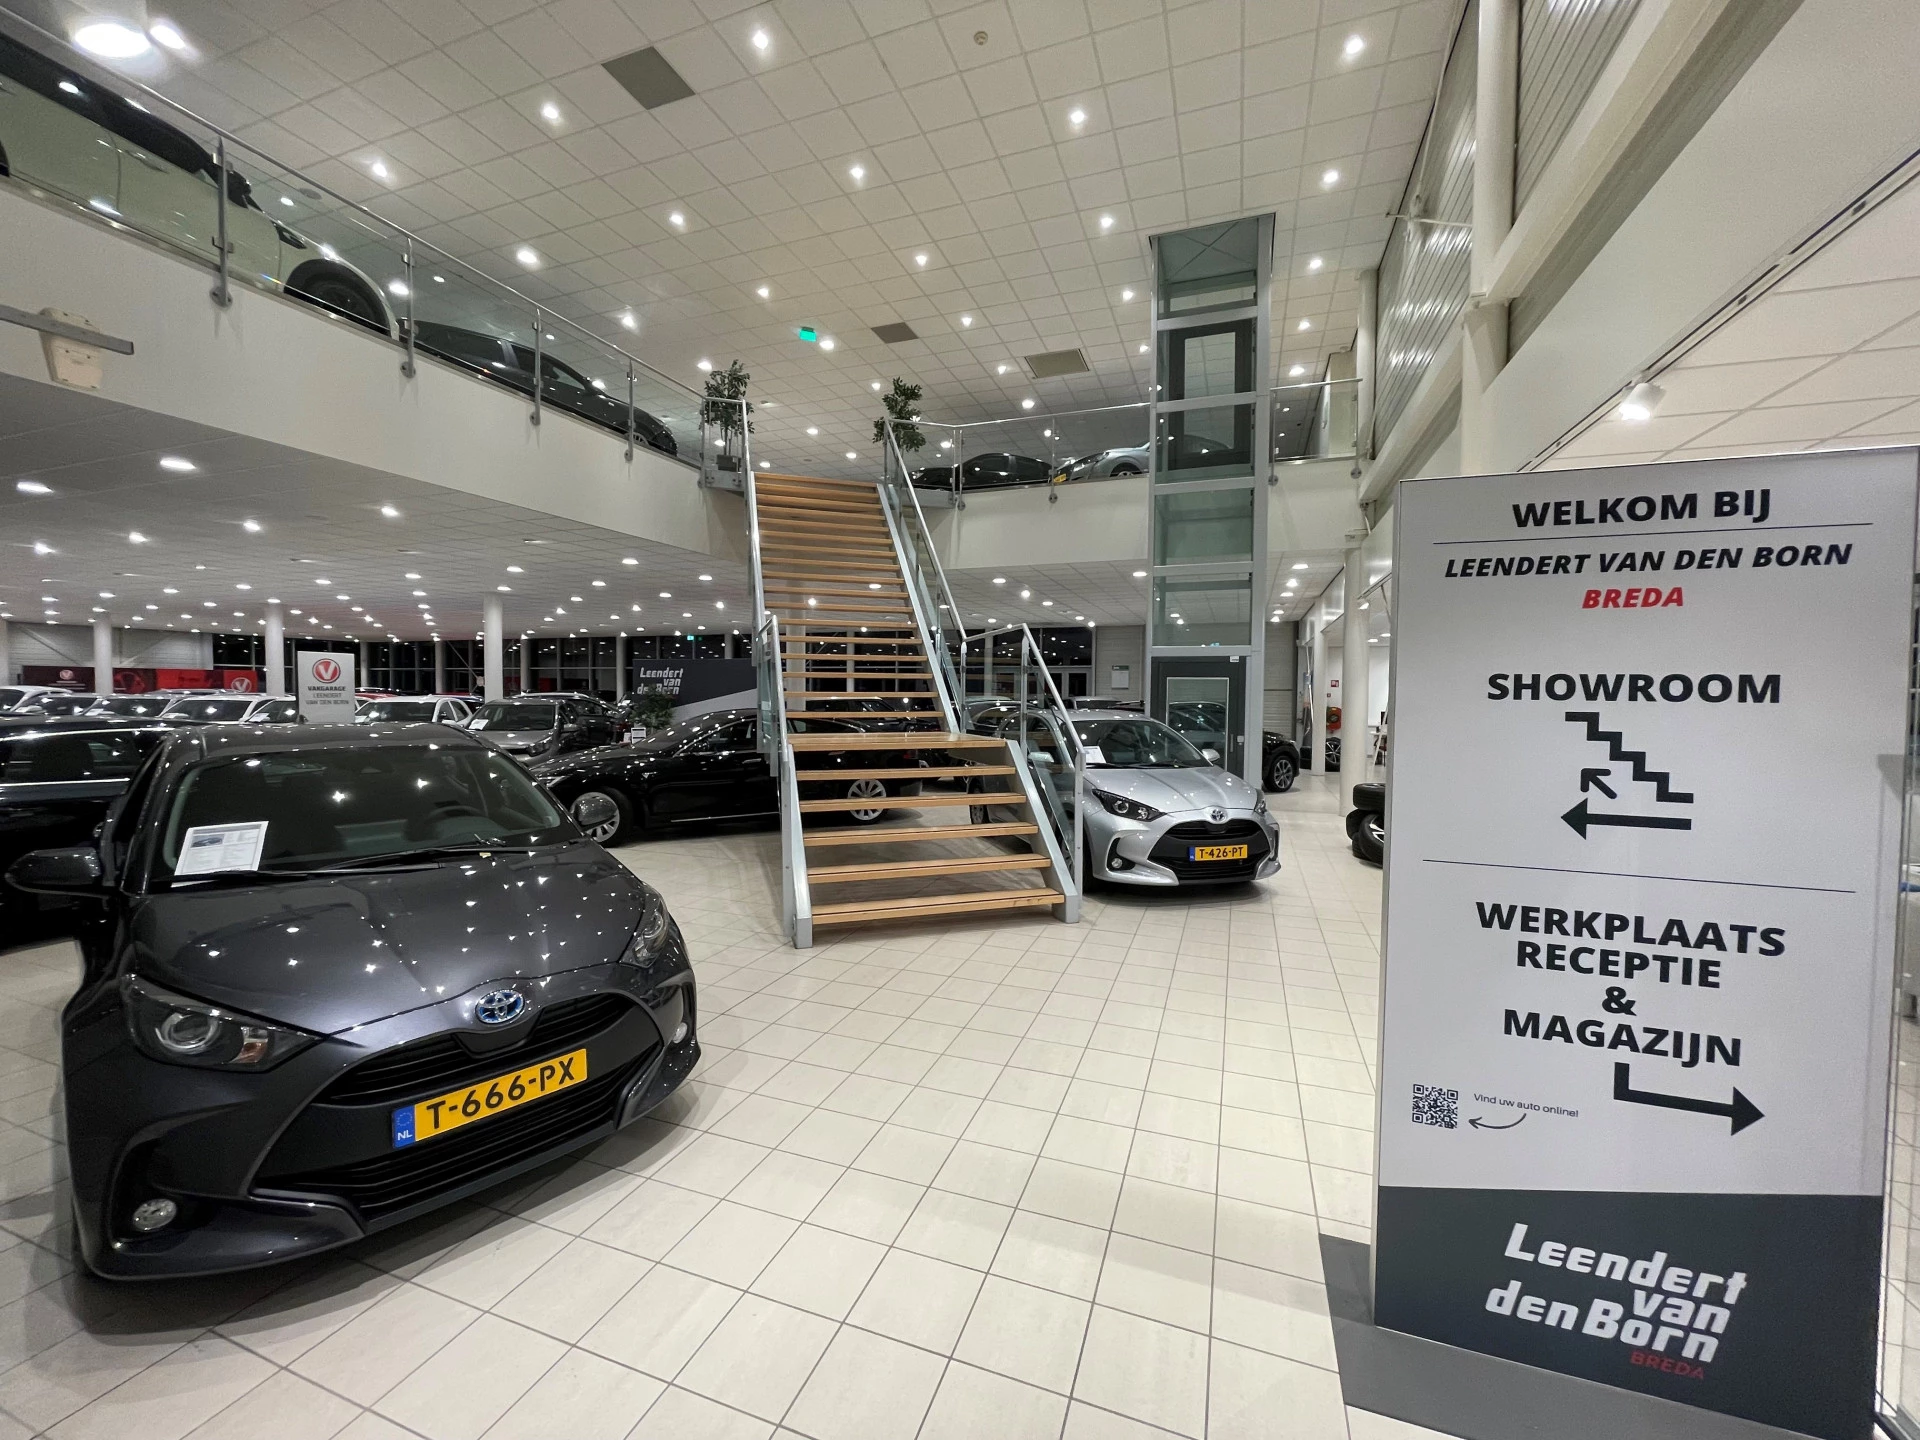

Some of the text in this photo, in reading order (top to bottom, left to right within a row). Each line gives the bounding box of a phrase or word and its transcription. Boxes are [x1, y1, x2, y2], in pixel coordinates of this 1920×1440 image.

[1512, 488, 1772, 528] WELKOM BIJ
[1445, 543, 1852, 578] LEENDERT VAN DEN BORN
[1582, 587, 1684, 609] BREDA
[640, 667, 684, 678] Leendert
[663, 678, 681, 686] van
[1488, 673, 1781, 704] SHOWROOM
[1199, 847, 1243, 858] T-426-PT
[1476, 901, 1786, 957] WERKPLAATS
[1517, 940, 1721, 989] RECEPTIE
[1602, 986, 1637, 1017] &
[1503, 1008, 1742, 1069] MAGAZIJN
[426, 1057, 575, 1130] T-666-PX
[1474, 1093, 1579, 1118] Vind uw auto online!
[397, 1130, 413, 1141] NL
[1504, 1222, 1747, 1305] Leendert
[1485, 1279, 1719, 1363] den Born
[1633, 1289, 1731, 1334] van
[1630, 1350, 1705, 1380] BREDA
